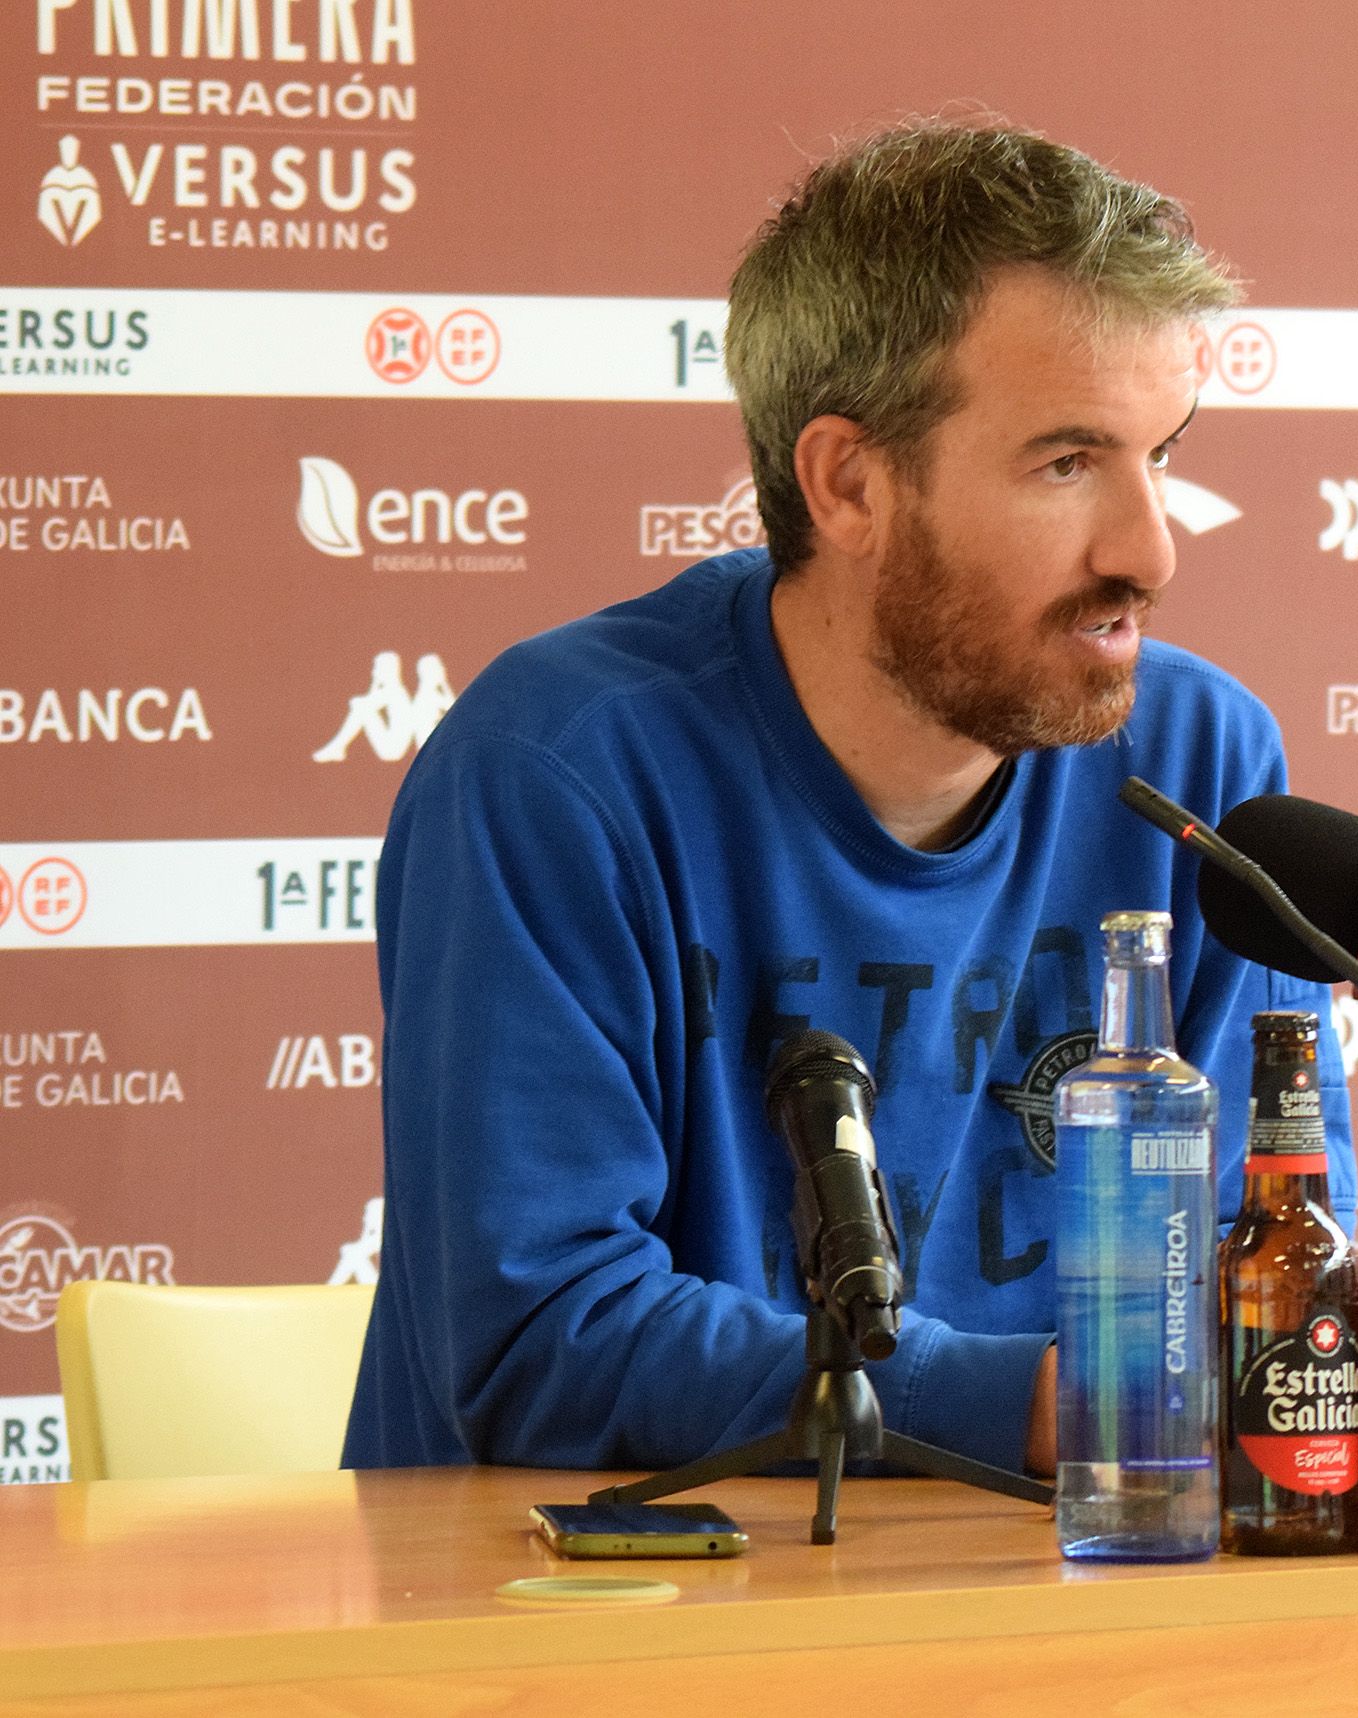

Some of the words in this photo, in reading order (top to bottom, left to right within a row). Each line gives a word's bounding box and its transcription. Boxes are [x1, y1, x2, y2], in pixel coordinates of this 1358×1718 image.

[38, 73, 417, 120] FEDERACIÓN
[110, 142, 417, 213] VERSUS
[149, 218, 390, 251] E-LEARNING
[41, 517, 192, 551] GALICIA
[367, 488, 529, 544] ence
[639, 504, 768, 556] PESC
[0, 1028, 108, 1067] UNTA
[35, 1069, 185, 1108] GALICIA
[1294, 1441, 1350, 1470] Especial
